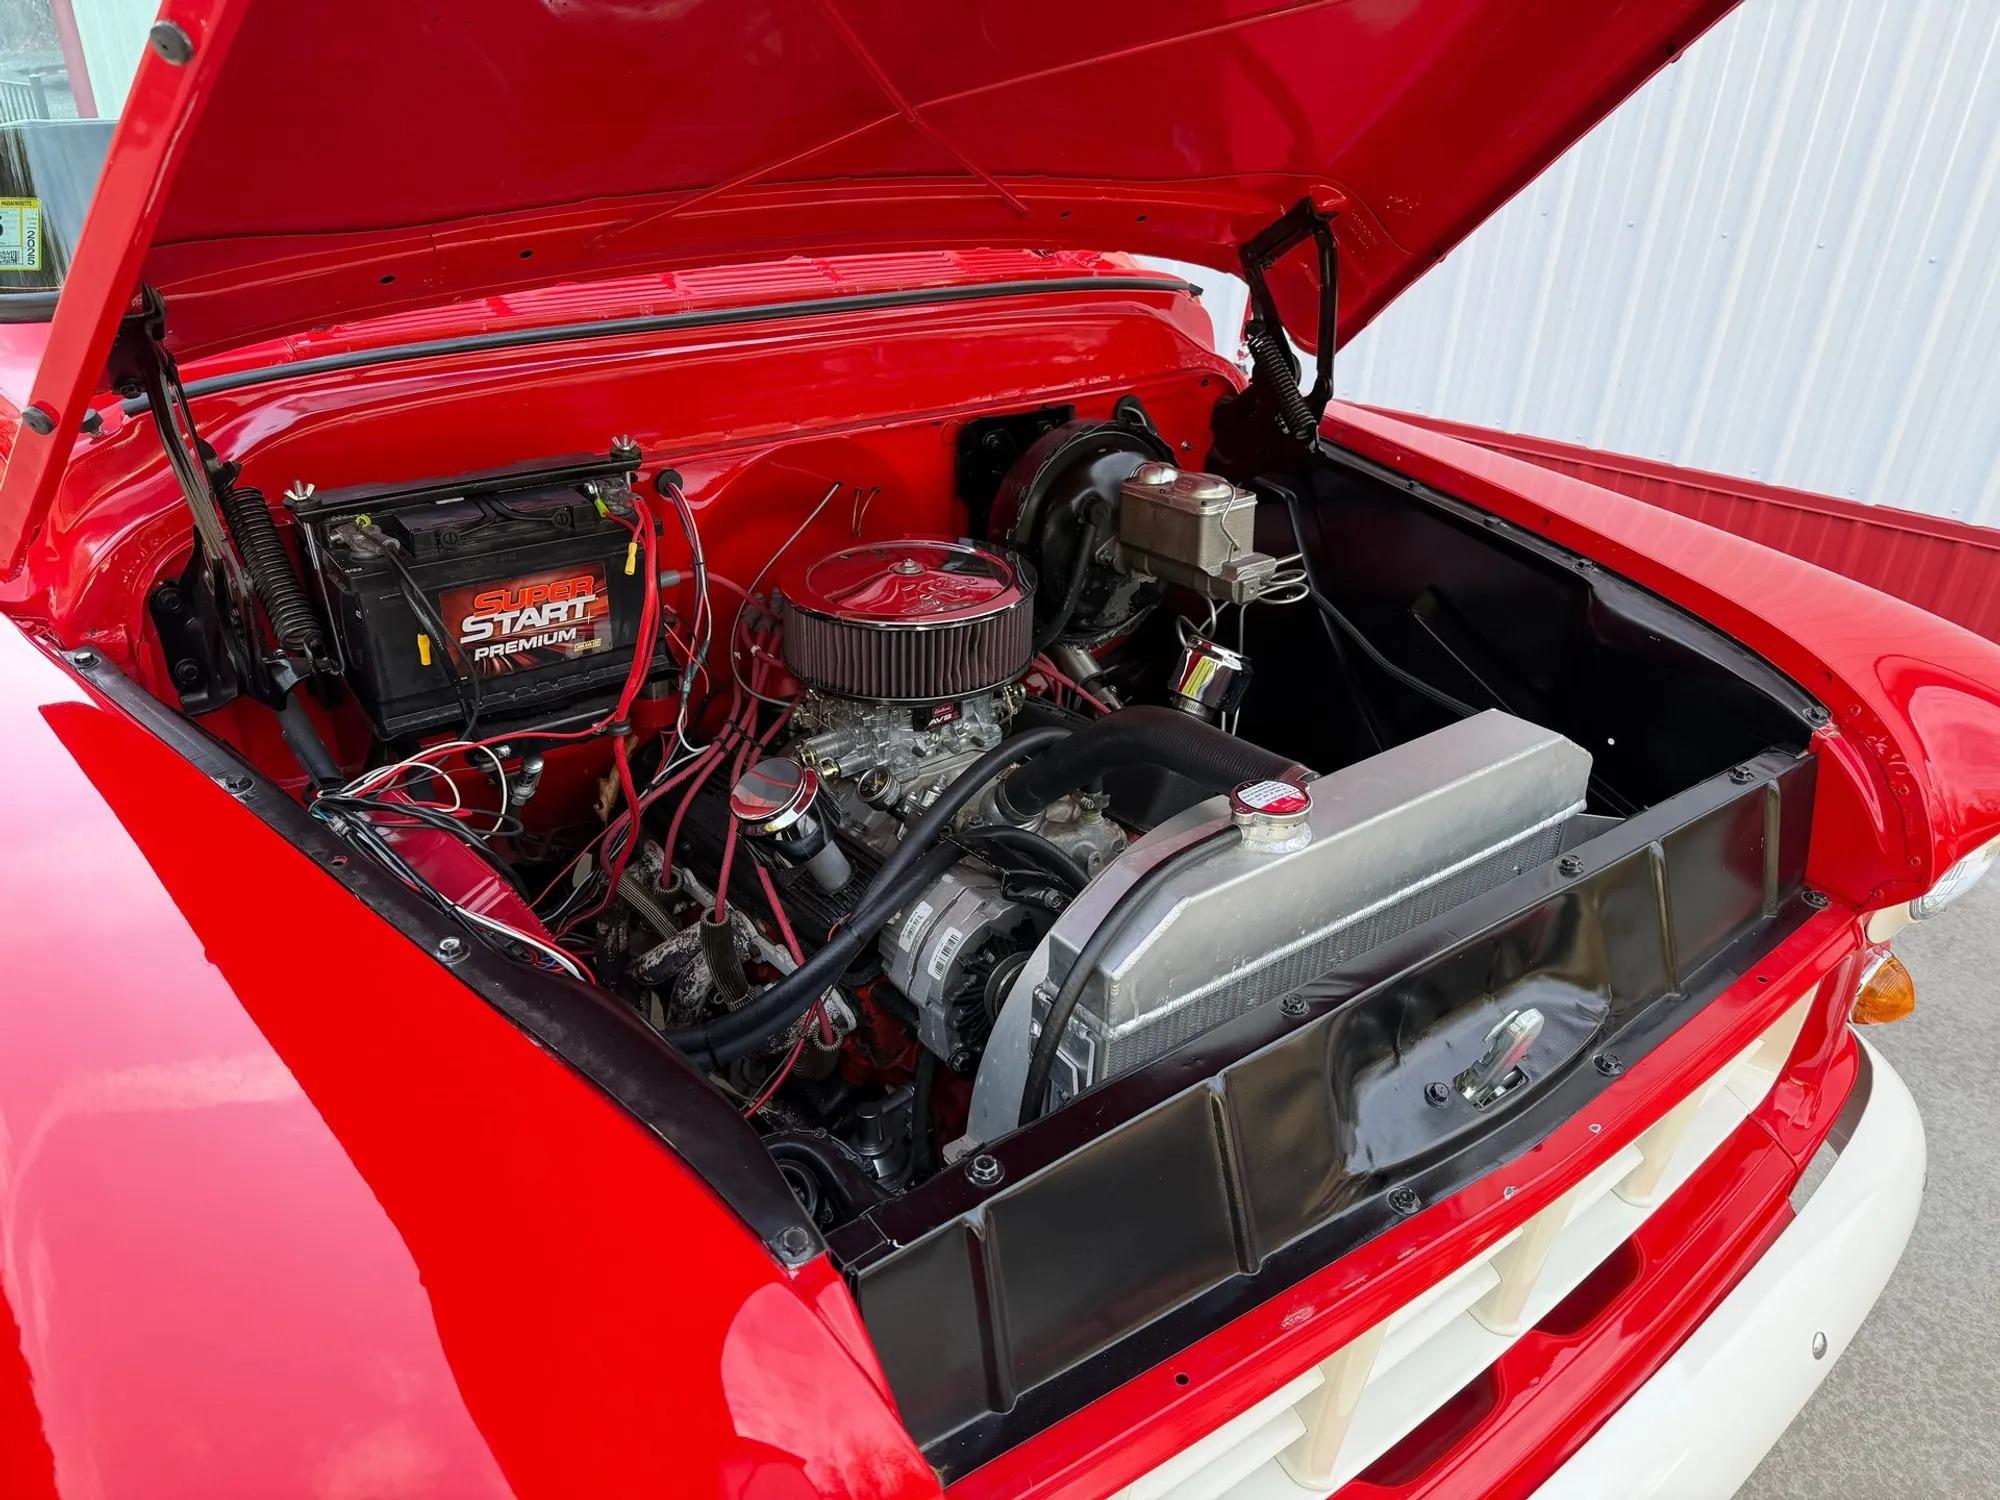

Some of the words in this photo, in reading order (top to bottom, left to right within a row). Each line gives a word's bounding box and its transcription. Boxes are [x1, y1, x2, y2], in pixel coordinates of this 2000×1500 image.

[27, 230, 36, 265] 2025
[473, 575, 595, 617] SUPER
[459, 593, 598, 644] START
[474, 627, 577, 662] PREMIUM
